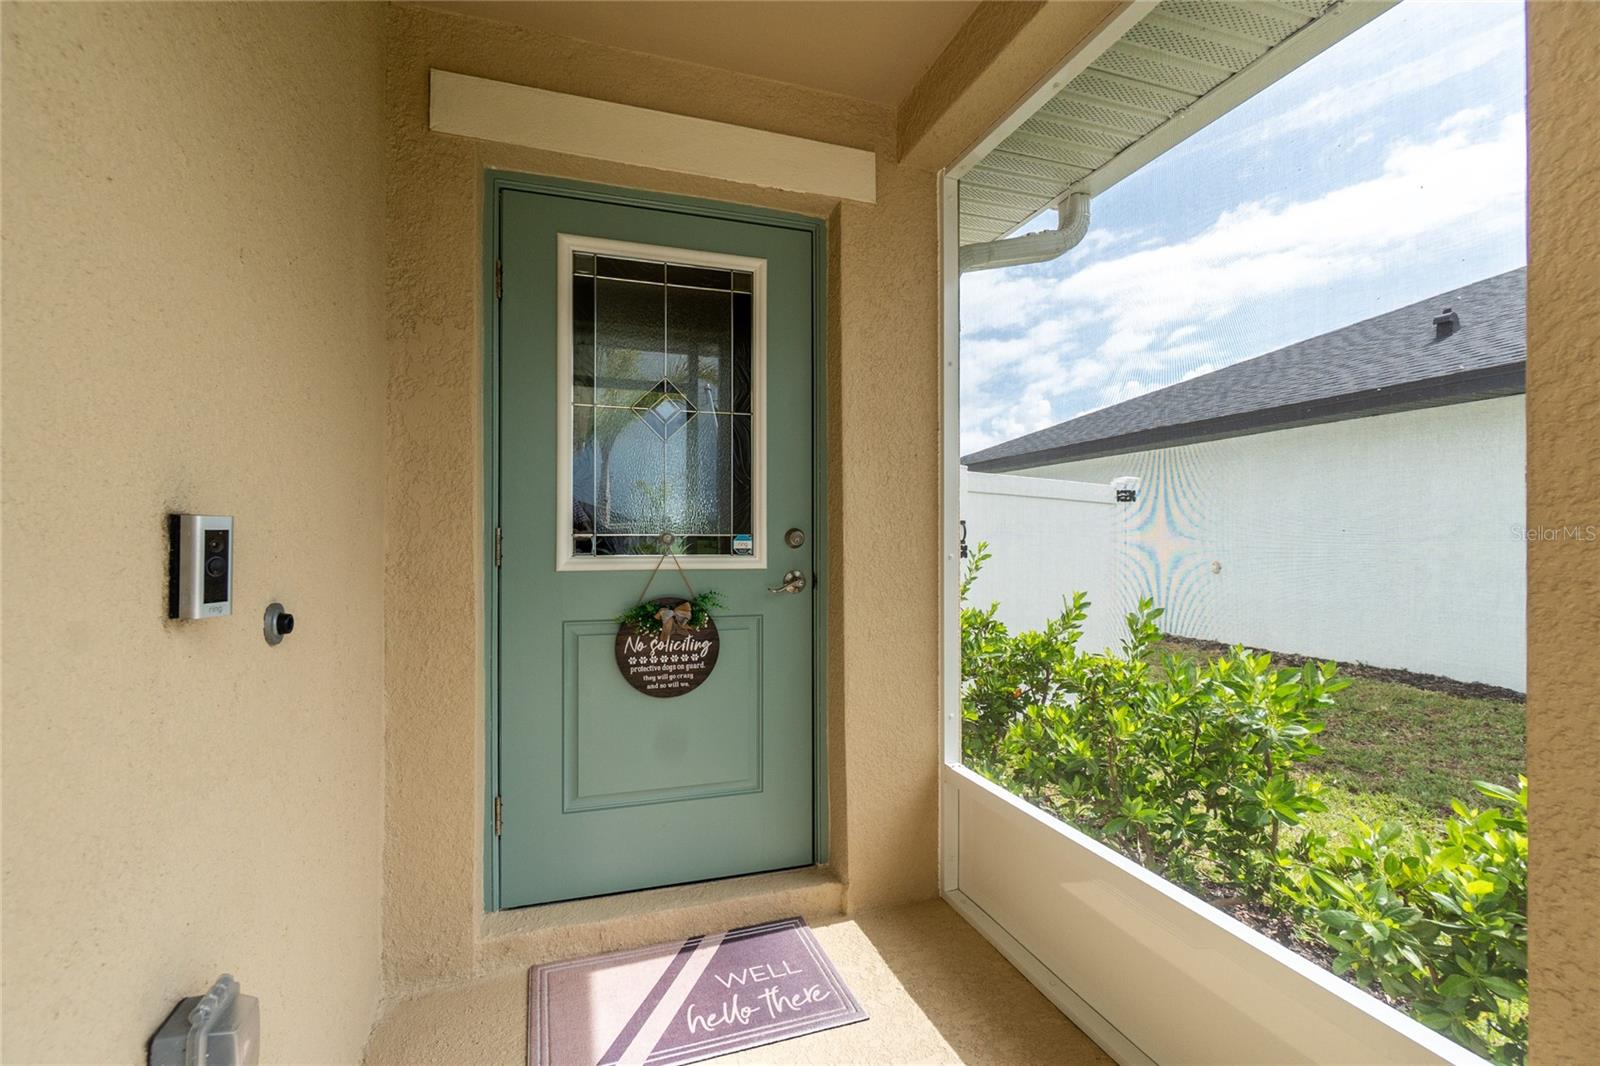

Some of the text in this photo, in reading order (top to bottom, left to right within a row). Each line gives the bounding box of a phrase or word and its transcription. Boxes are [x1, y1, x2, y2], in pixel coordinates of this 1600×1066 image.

[624, 636, 647, 654] No
[630, 664, 661, 674] protective
[662, 663, 676, 672] dogs
[643, 674, 656, 682] they
[714, 960, 803, 989] WELL
[687, 984, 831, 1034] hello there
